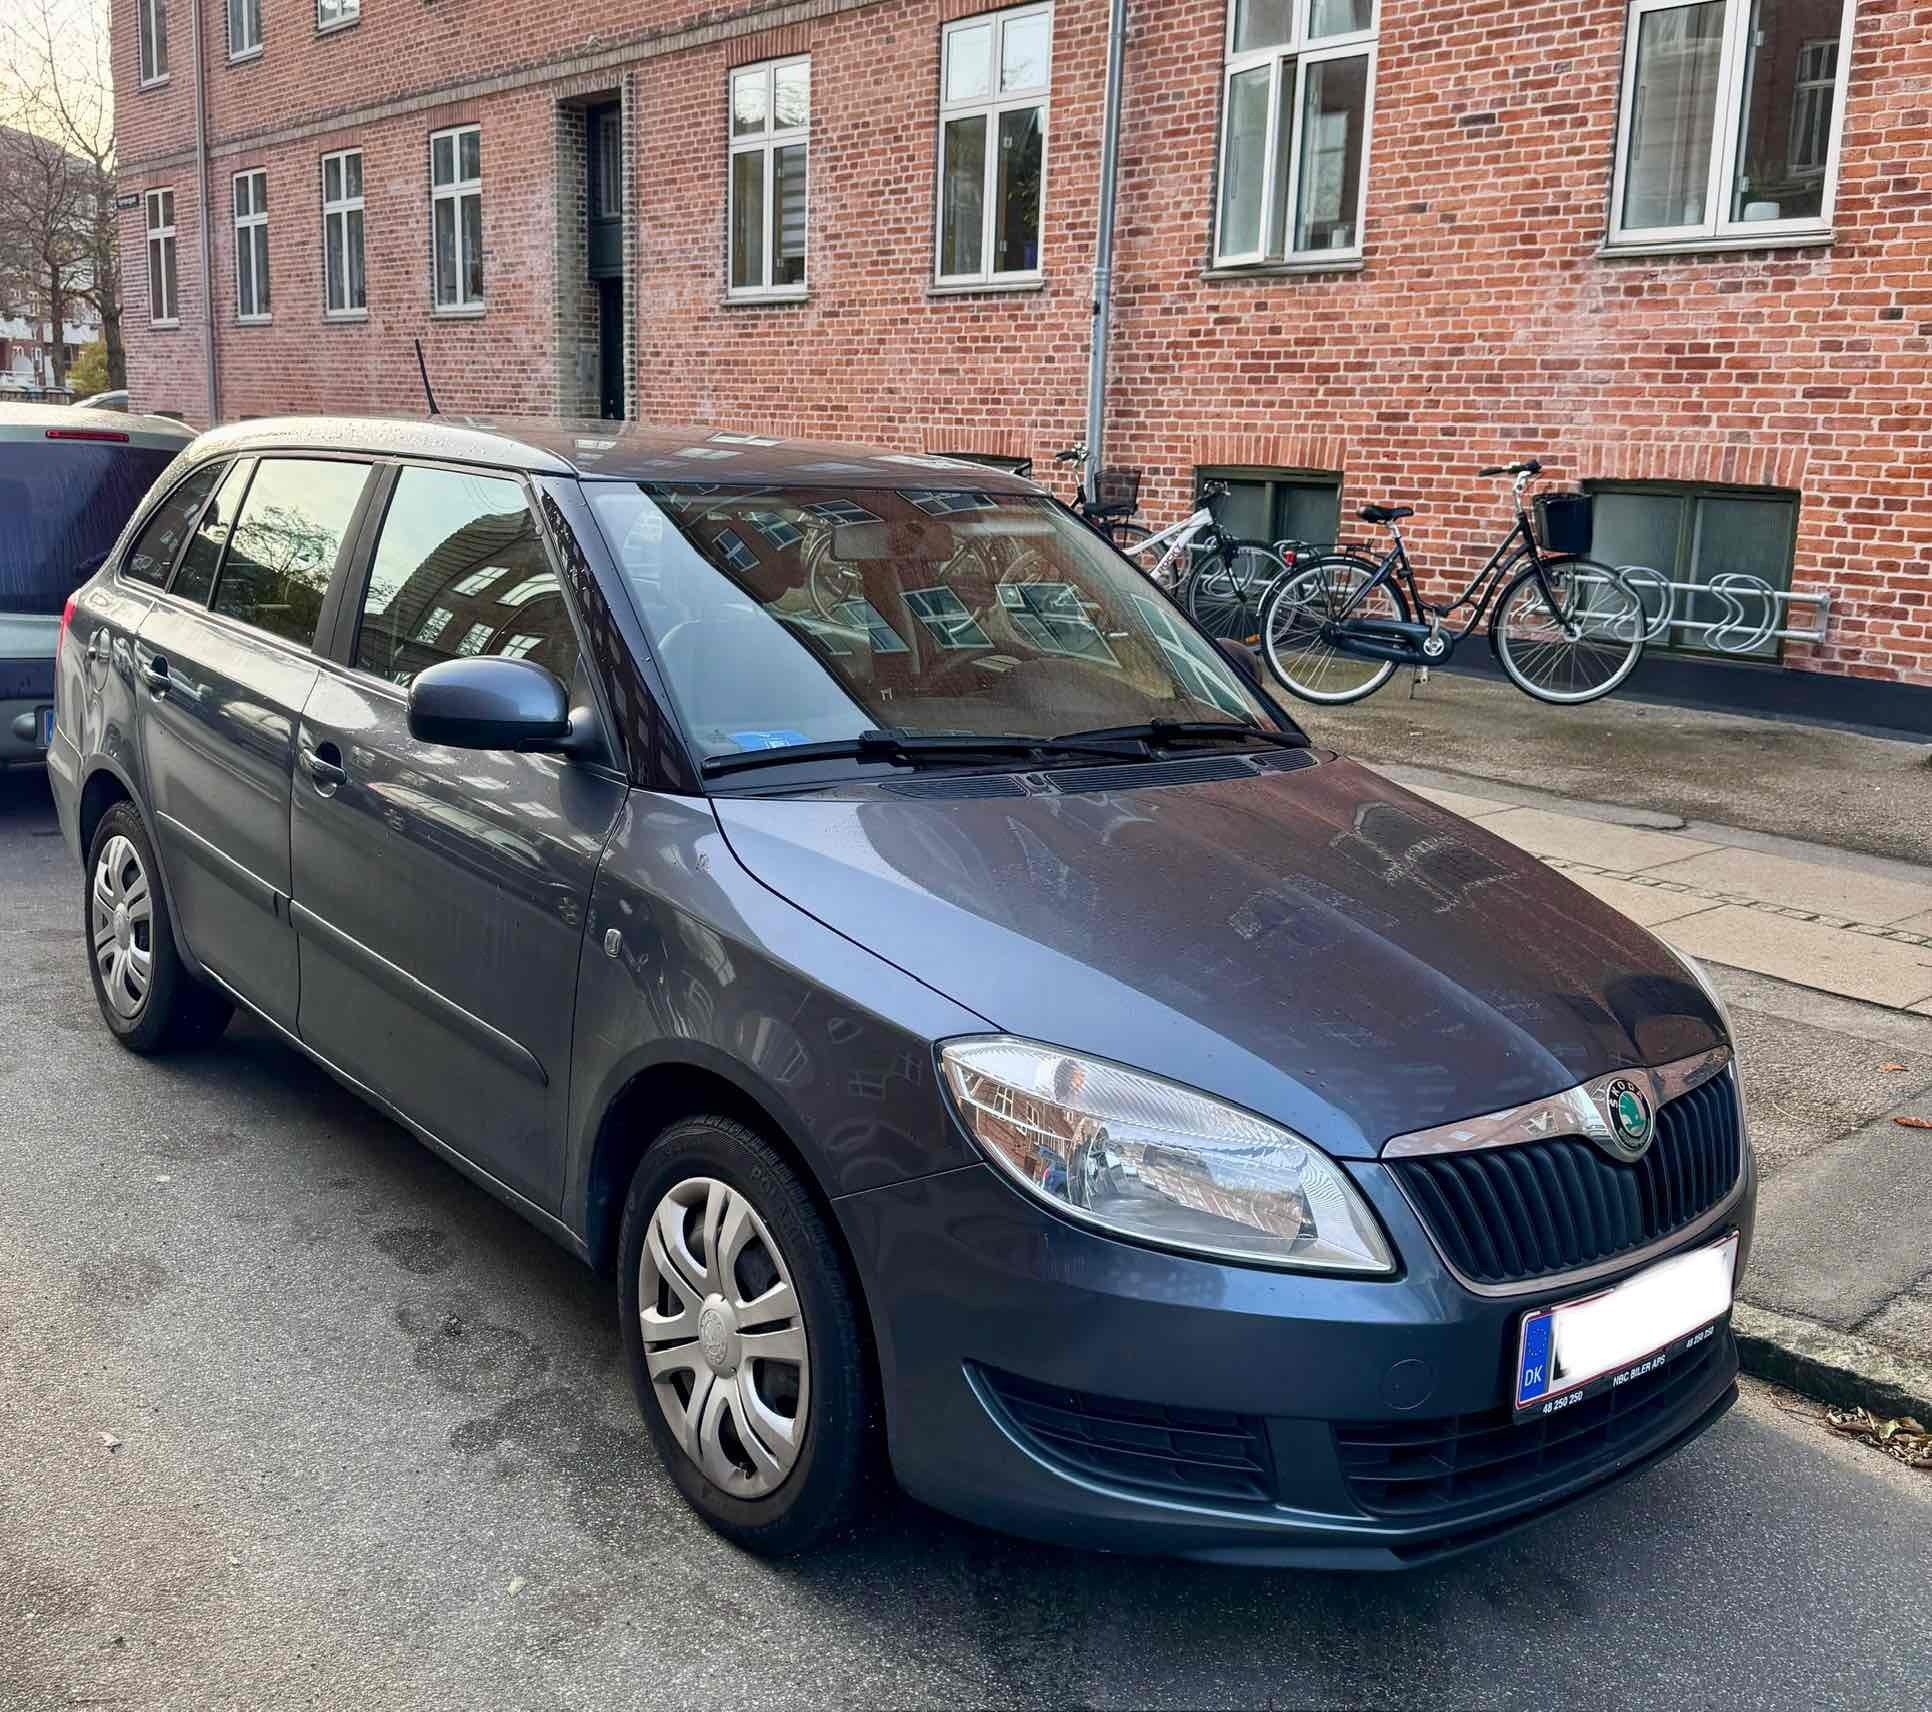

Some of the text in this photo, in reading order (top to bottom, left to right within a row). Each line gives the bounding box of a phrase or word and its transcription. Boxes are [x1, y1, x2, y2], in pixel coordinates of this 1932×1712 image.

[1524, 1364, 1543, 1387] DK
[1630, 1361, 1652, 1380] BILER
[1651, 1354, 1666, 1371] APS
[1553, 1396, 1568, 1410] 250
[1569, 1390, 1584, 1405] 250
